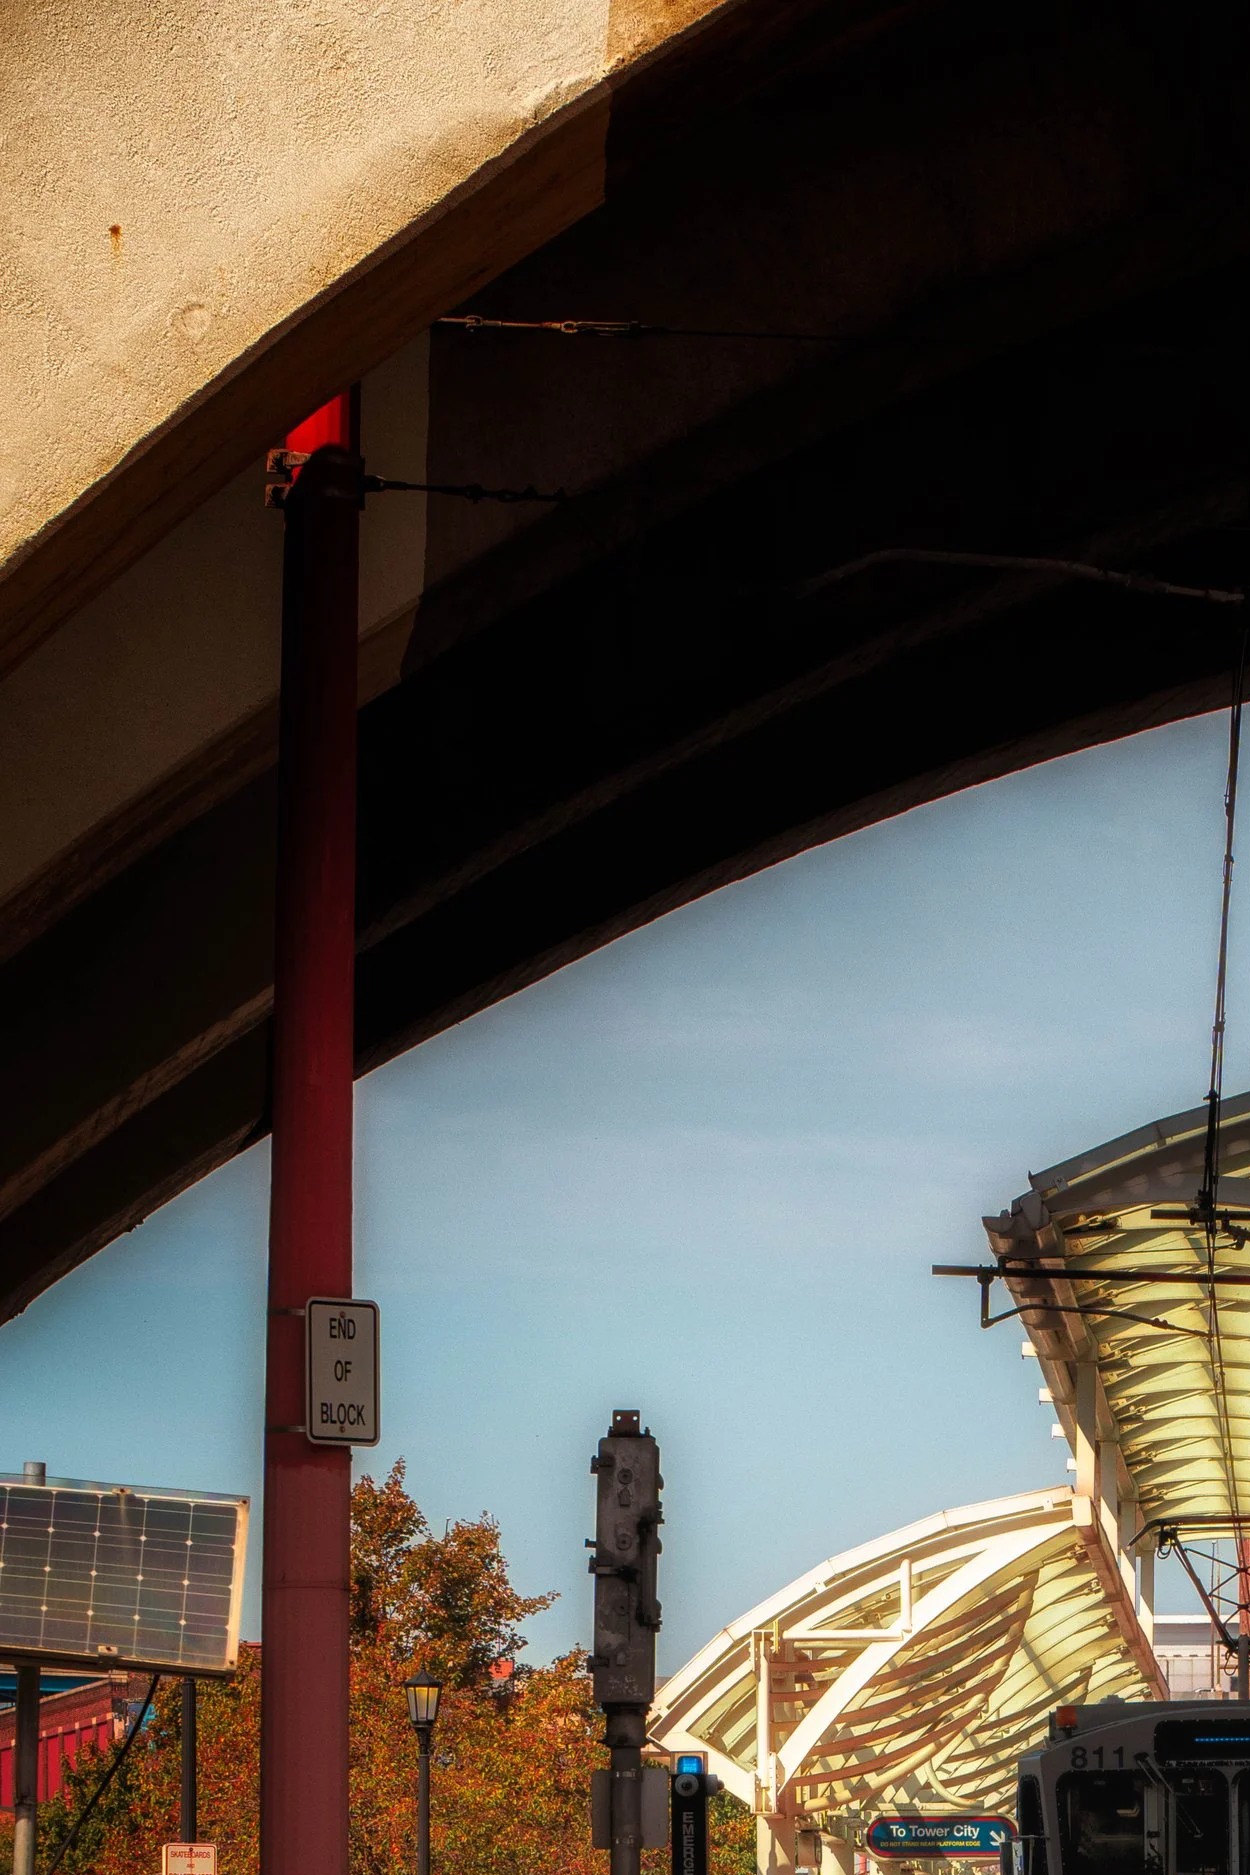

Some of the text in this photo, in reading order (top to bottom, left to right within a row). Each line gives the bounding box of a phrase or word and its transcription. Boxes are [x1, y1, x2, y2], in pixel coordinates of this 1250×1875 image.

[329, 1317, 356, 1340] END
[334, 1359, 352, 1382] OF
[320, 1402, 366, 1426] BLOCK
[1071, 1746, 1124, 1769] 811
[889, 1824, 980, 1839] To Tower City
